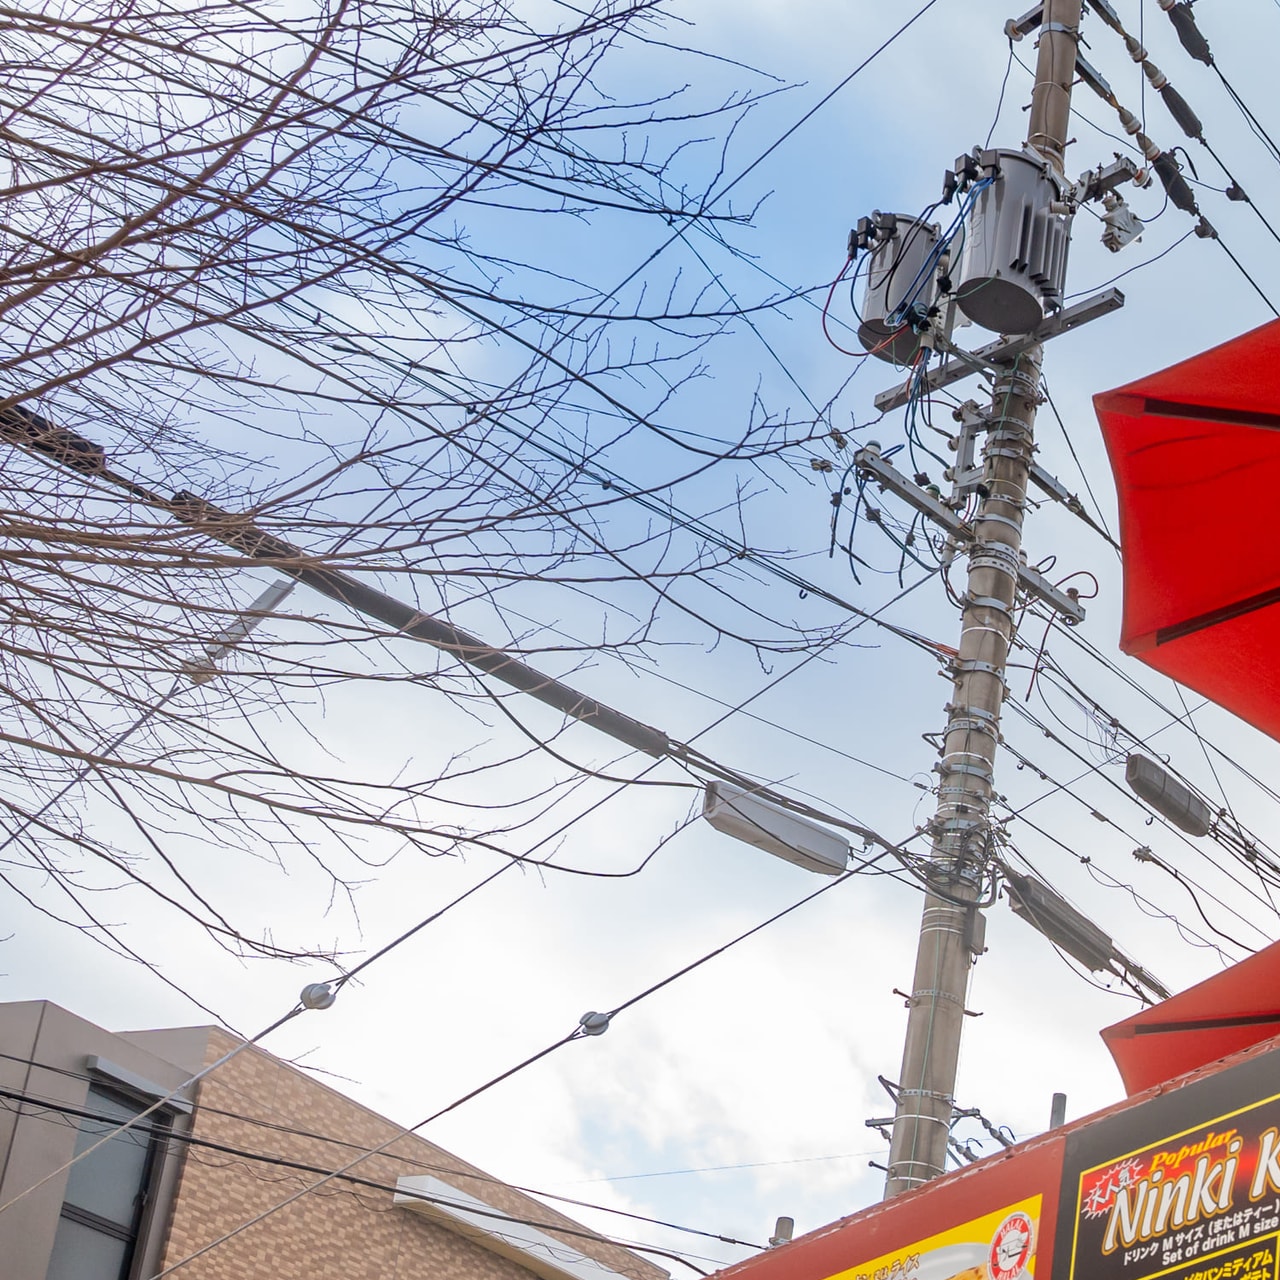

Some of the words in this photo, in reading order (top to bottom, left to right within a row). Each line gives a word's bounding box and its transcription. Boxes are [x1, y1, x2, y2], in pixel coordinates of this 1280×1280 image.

[1150, 1129, 1238, 1172] Popular
[1102, 1138, 1243, 1255] Ninki
[1162, 1249, 1182, 1265] Set
[1185, 1242, 1199, 1257] of
[1202, 1232, 1235, 1253] drink
[1239, 1224, 1250, 1238] M
[1253, 1216, 1279, 1234] size
